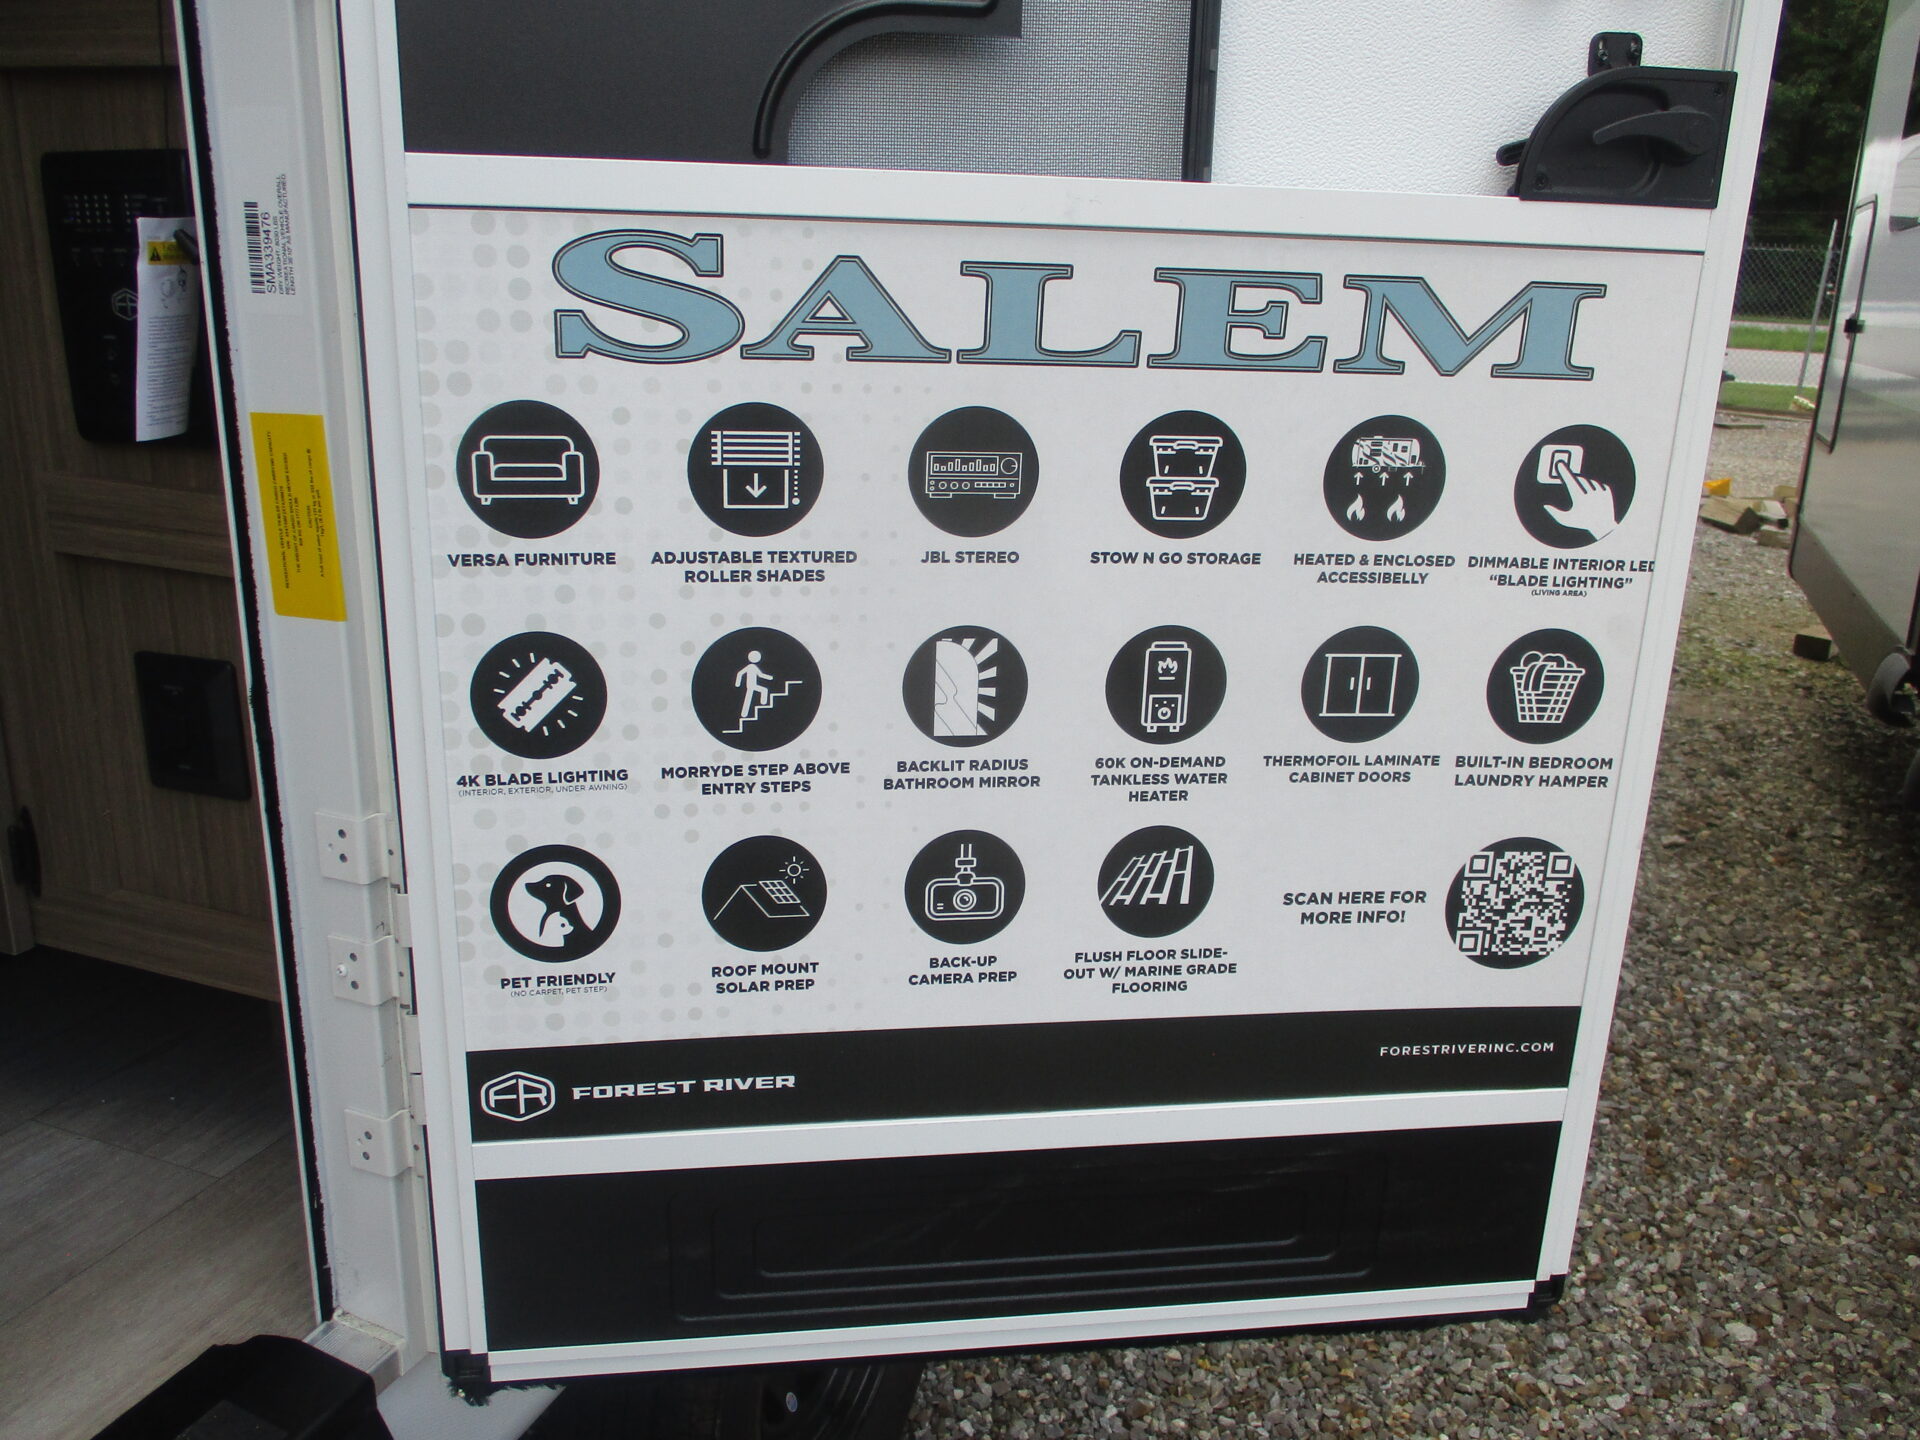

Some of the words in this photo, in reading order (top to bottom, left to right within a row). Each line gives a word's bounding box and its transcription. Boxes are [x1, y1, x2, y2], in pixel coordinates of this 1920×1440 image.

[261, 211, 277, 294] SMA339476
[281, 242, 289, 294] RECREATIONAL
[552, 229, 1606, 380] SALEM
[447, 553, 510, 567] VERSA
[515, 552, 616, 566] FURNITURE
[651, 551, 763, 564] ADJUSTABLE
[767, 551, 857, 563] TEXTURED
[921, 551, 950, 563] JBL
[955, 551, 1019, 564] STEREO
[1090, 552, 1139, 564] STOW
[1143, 552, 1154, 564] N
[1159, 552, 1183, 564] GO
[1187, 552, 1261, 565] STORAGE
[1294, 553, 1355, 566] HEATED
[1359, 554, 1369, 566] &
[1373, 554, 1455, 567] ENCLOSED
[1468, 556, 1549, 569] DIMMABLE
[1553, 558, 1625, 572] INTERIOR
[685, 570, 752, 583] ROLLER
[756, 569, 825, 582] SHADES
[1317, 571, 1429, 584] ACCESSIBELLY
[1531, 589, 1560, 597] (LIVING
[1562, 590, 1587, 598] AREA)
[897, 760, 965, 772] BACKLIT
[969, 759, 1028, 771] RADIUS
[1095, 757, 1126, 769] 60K
[1130, 756, 1226, 769] ON-DEMAND
[1263, 755, 1360, 767] THERMOFOIL
[1364, 755, 1440, 766] LAMINATE
[1455, 756, 1524, 768] BUILT-IN
[1529, 756, 1613, 770] BEDROOM
[661, 765, 743, 779] MORRYDE
[748, 764, 789, 776] STEP
[793, 762, 850, 775] ABOVE
[1289, 771, 1355, 783] CABINET
[1358, 771, 1411, 782] DOORS
[456, 775, 480, 787] 4K
[485, 772, 543, 786] BLADE
[548, 769, 628, 785] LIGHTING
[884, 776, 974, 791] BATHROOM
[980, 775, 1041, 788] MIRROR
[1091, 773, 1169, 786] TANKLESS
[1174, 773, 1228, 784] WATER
[1454, 774, 1535, 787] LAUNDRY
[1539, 775, 1608, 788] HAMPER
[458, 789, 506, 797] (INTERIOR,
[508, 786, 554, 795] EXTERIOR,
[556, 785, 585, 793] UNDER
[588, 783, 628, 791] AWNING)
[702, 782, 756, 795] ENTRY
[760, 780, 811, 793] STEPS
[1129, 790, 1188, 802] HEATER
[1283, 892, 1333, 906] SCAN
[1338, 891, 1385, 904] HERE
[1390, 891, 1427, 903] FOR
[1301, 911, 1352, 925] MORE
[1357, 910, 1406, 923] INFO!
[930, 955, 997, 968] BACK-UP
[1075, 951, 1122, 963] FLUSH
[1127, 949, 1176, 961] FLOOR
[1180, 948, 1228, 959] SLIDE-
[712, 965, 757, 978] ROOF
[761, 962, 819, 975] MOUNT
[1063, 967, 1095, 979] OUT
[1099, 966, 1121, 979] W/
[1125, 965, 1182, 977] MARINE
[1186, 963, 1237, 975] GRADE
[500, 977, 532, 989] PET
[537, 972, 616, 987] FRIENDLY
[908, 972, 974, 985] CAMERA
[978, 971, 1017, 983] PREP
[511, 989, 526, 997] (NO
[529, 987, 564, 996] CARPET,
[566, 987, 581, 995] PET
[584, 985, 607, 993] STEP)
[716, 981, 770, 994] SOLAR
[775, 979, 815, 991] PREP
[1112, 980, 1187, 994] FLOORING
[1380, 1042, 1555, 1057] FORESTRIVERINC.COM
[572, 1080, 696, 1100] FOREST
[703, 1075, 795, 1092] RIVER
